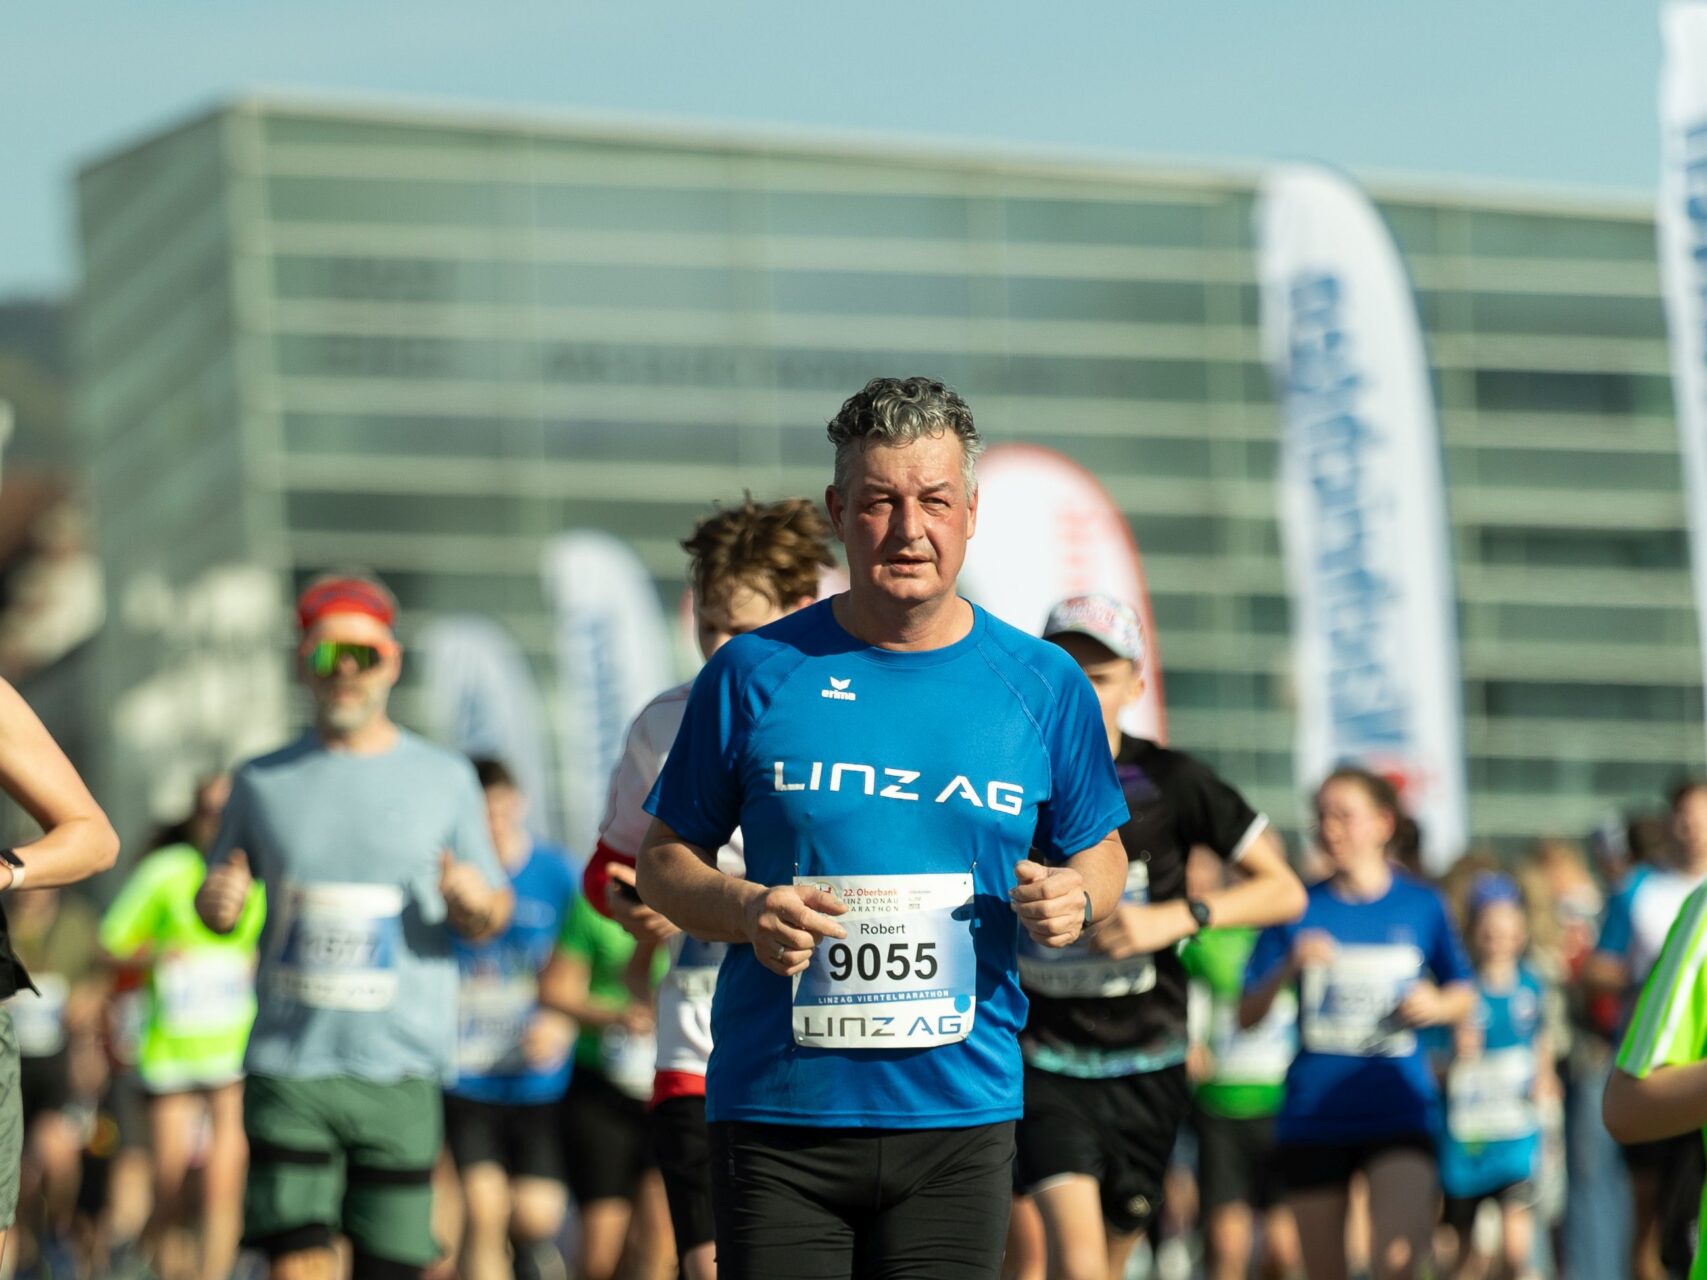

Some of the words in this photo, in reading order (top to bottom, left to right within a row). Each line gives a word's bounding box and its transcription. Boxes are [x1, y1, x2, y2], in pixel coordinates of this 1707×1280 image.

[821, 688, 856, 701] erima
[774, 761, 921, 801] LINZ
[935, 775, 1024, 816] AG
[843, 888, 855, 897] 22.
[857, 888, 898, 897] Oberbank
[866, 897, 899, 905] DONAU
[860, 923, 905, 935] Robert
[828, 942, 938, 981] 9055
[857, 989, 949, 1003] VIERTELMARATHON
[804, 1016, 895, 1038] LINZ
[907, 1015, 962, 1037] AG
